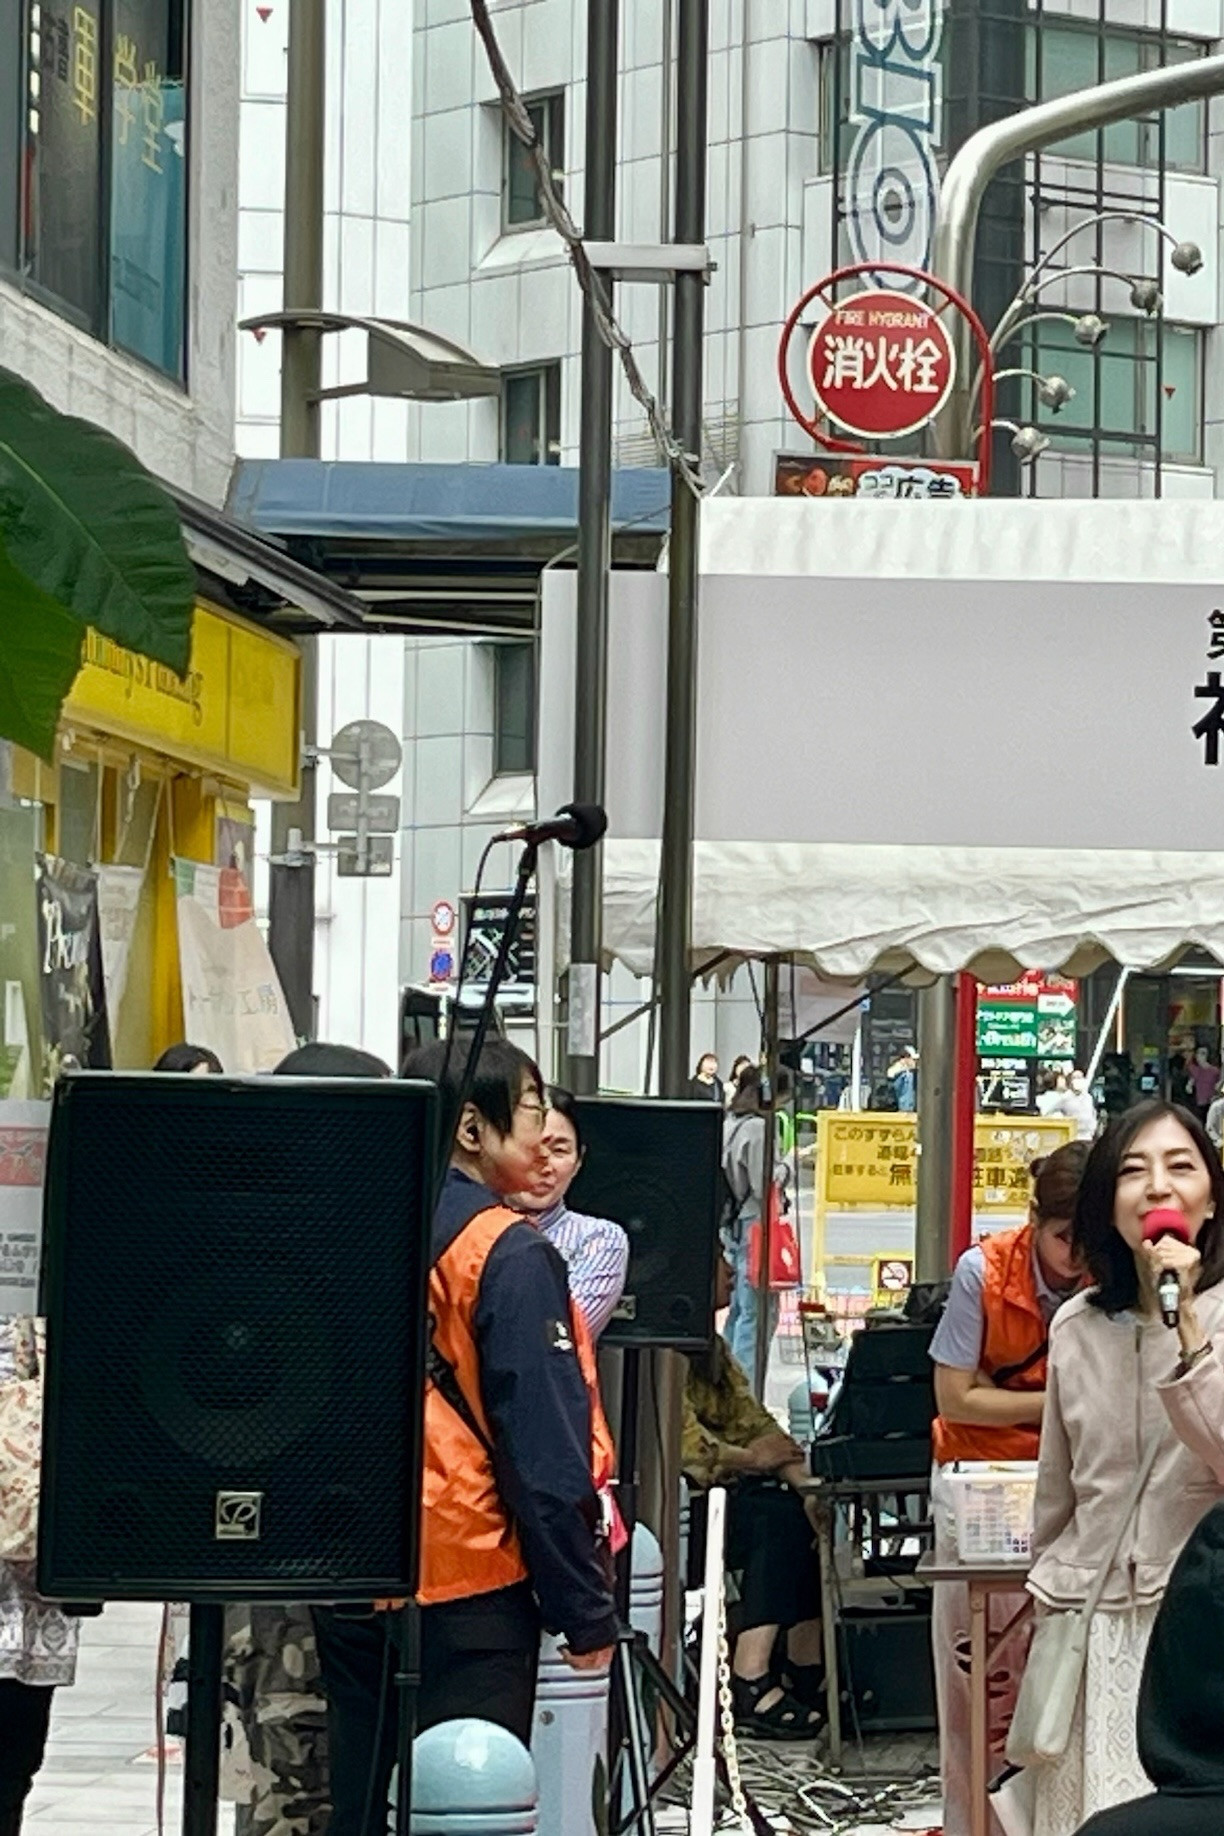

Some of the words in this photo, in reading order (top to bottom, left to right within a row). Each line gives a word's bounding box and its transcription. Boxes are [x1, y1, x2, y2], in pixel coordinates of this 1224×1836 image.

[835, 311, 865, 326] FIRE
[869, 311, 930, 328] HYDRANT
[822, 334, 943, 393] 消火栓
